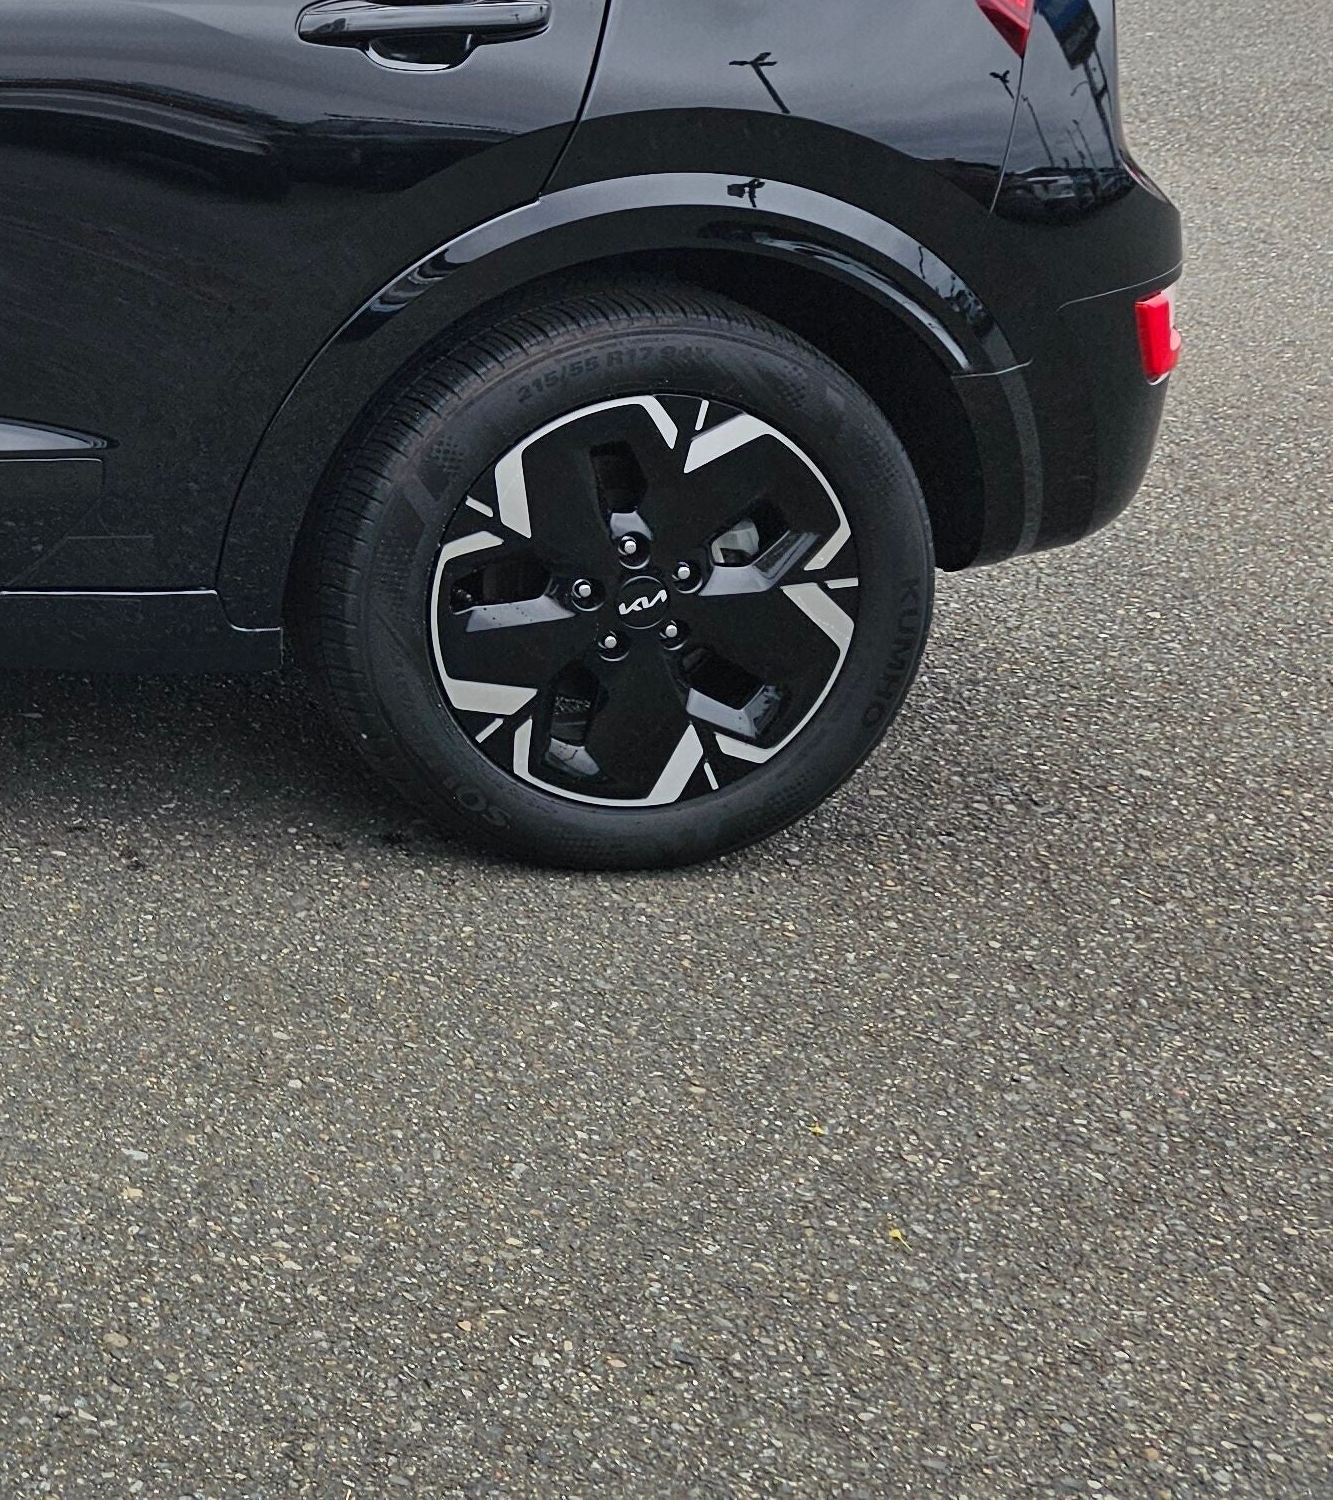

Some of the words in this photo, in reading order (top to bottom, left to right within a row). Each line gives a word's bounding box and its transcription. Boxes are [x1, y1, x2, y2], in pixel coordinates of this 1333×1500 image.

[517, 355, 600, 403] 215/55
[606, 345, 653, 368] R17
[860, 577, 922, 728] KUMHO
